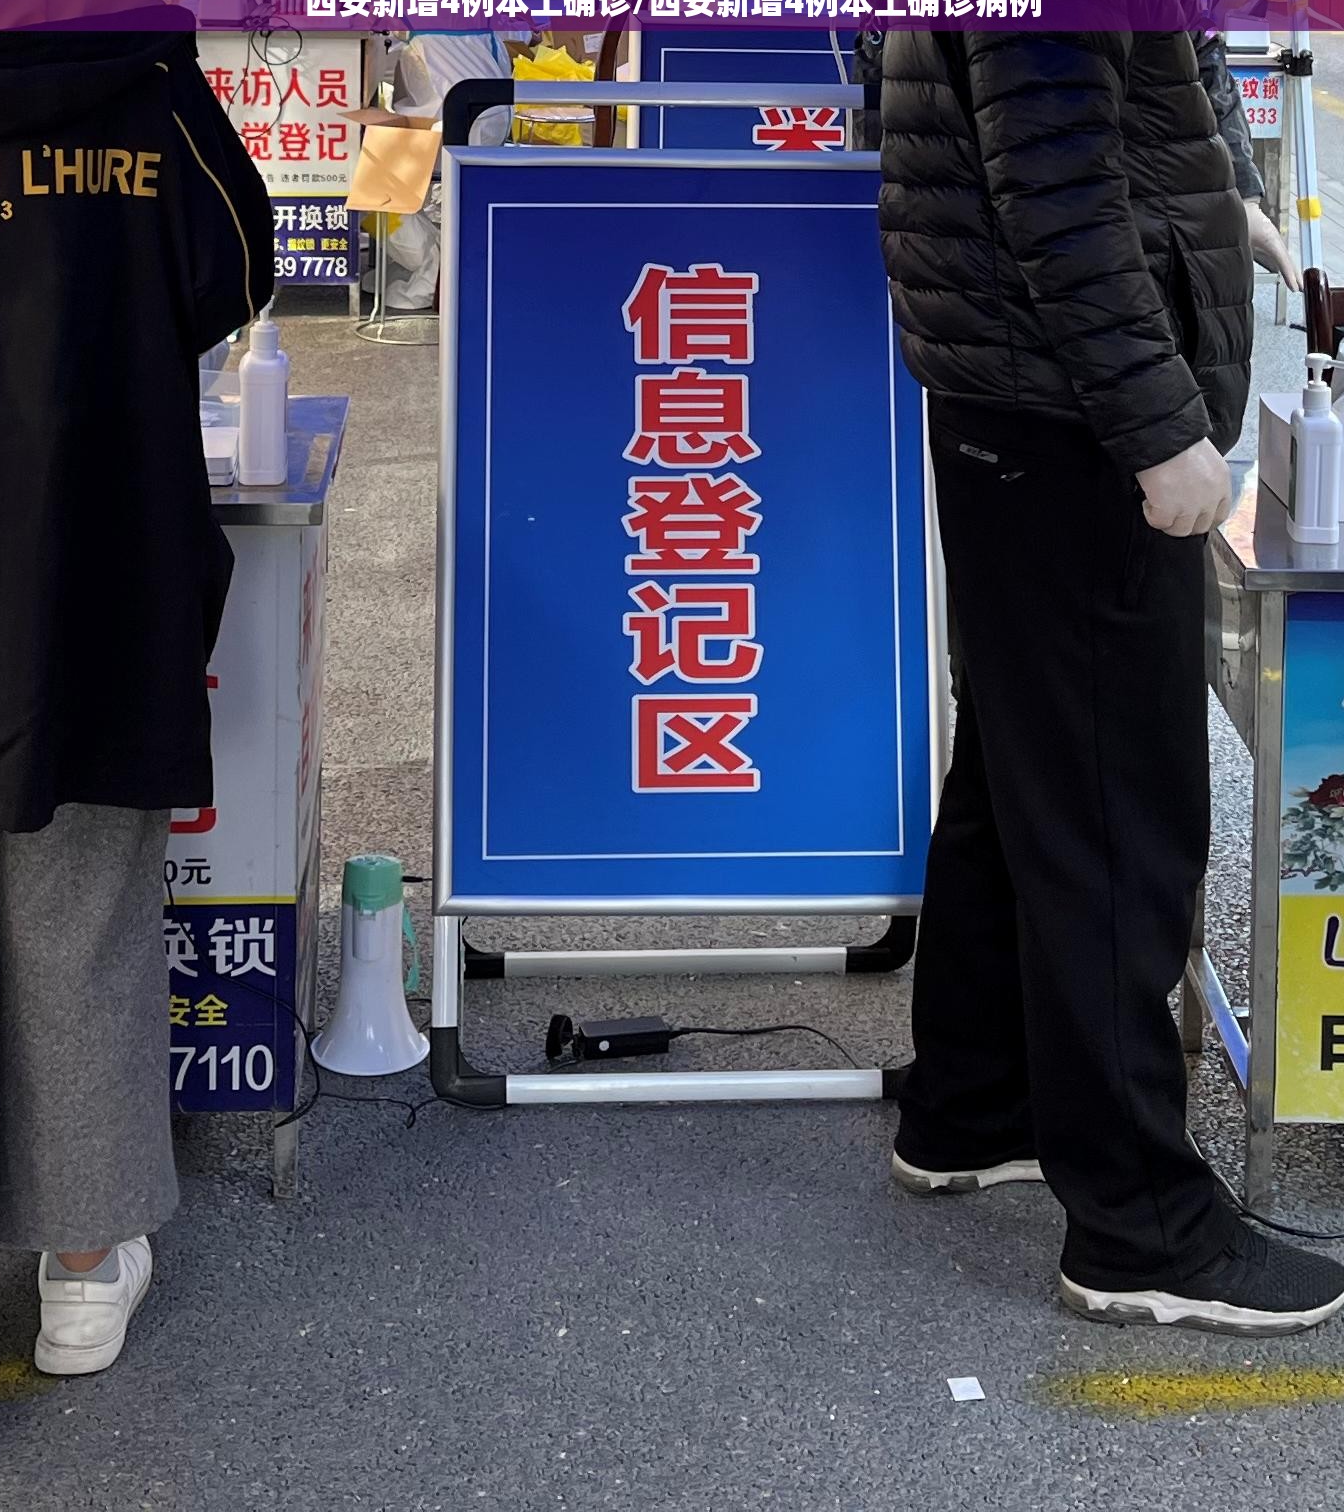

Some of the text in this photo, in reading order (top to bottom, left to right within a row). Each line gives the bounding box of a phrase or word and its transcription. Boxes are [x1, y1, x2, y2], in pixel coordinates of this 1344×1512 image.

[205, 67, 348, 108] 来访人员
[273, 204, 349, 231] 开换锁
[622, 262, 763, 793] 信息登记区
[170, 1044, 275, 1092] 7110
